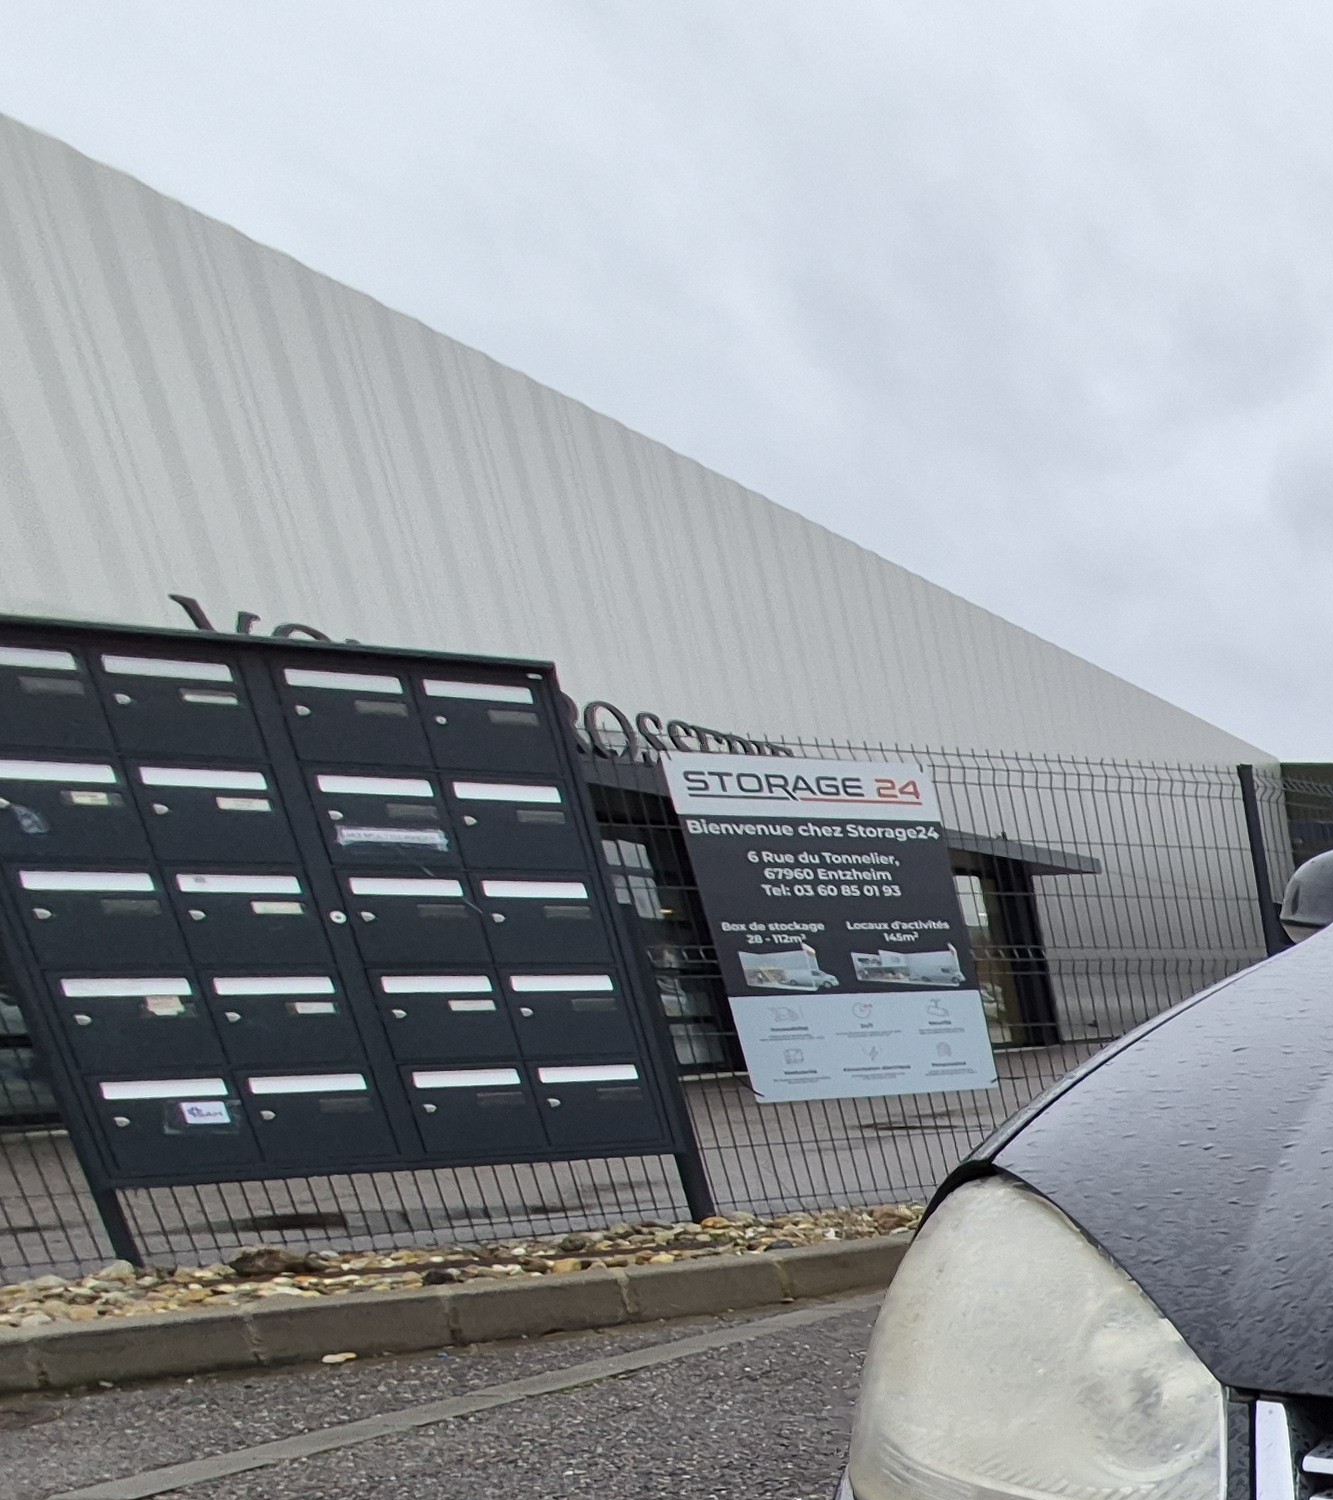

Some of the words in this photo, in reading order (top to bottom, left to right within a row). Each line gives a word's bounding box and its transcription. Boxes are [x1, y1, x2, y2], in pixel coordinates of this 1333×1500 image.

[683, 770, 865, 800] STORAGE
[874, 778, 921, 800] 24
[686, 819, 794, 837] Bienvenue
[798, 822, 843, 838] chez
[847, 824, 940, 842] Storage24
[747, 851, 759, 863] 6
[761, 851, 795, 863] Rue
[798, 851, 820, 864] du
[821, 852, 900, 867] Tonnelier,
[764, 867, 814, 880] 67960
[816, 868, 892, 881] Entzheim
[760, 883, 792, 896] Tel:
[793, 884, 815, 896] 03
[817, 884, 838, 897] 60
[840, 884, 861, 897] 85
[863, 885, 880, 897] 01
[882, 885, 902, 897] 93
[721, 921, 747, 931] Box
[749, 921, 766, 931] de
[768, 921, 825, 932] stockage
[845, 920, 889, 930] Locaux
[891, 919, 950, 930] d'activités
